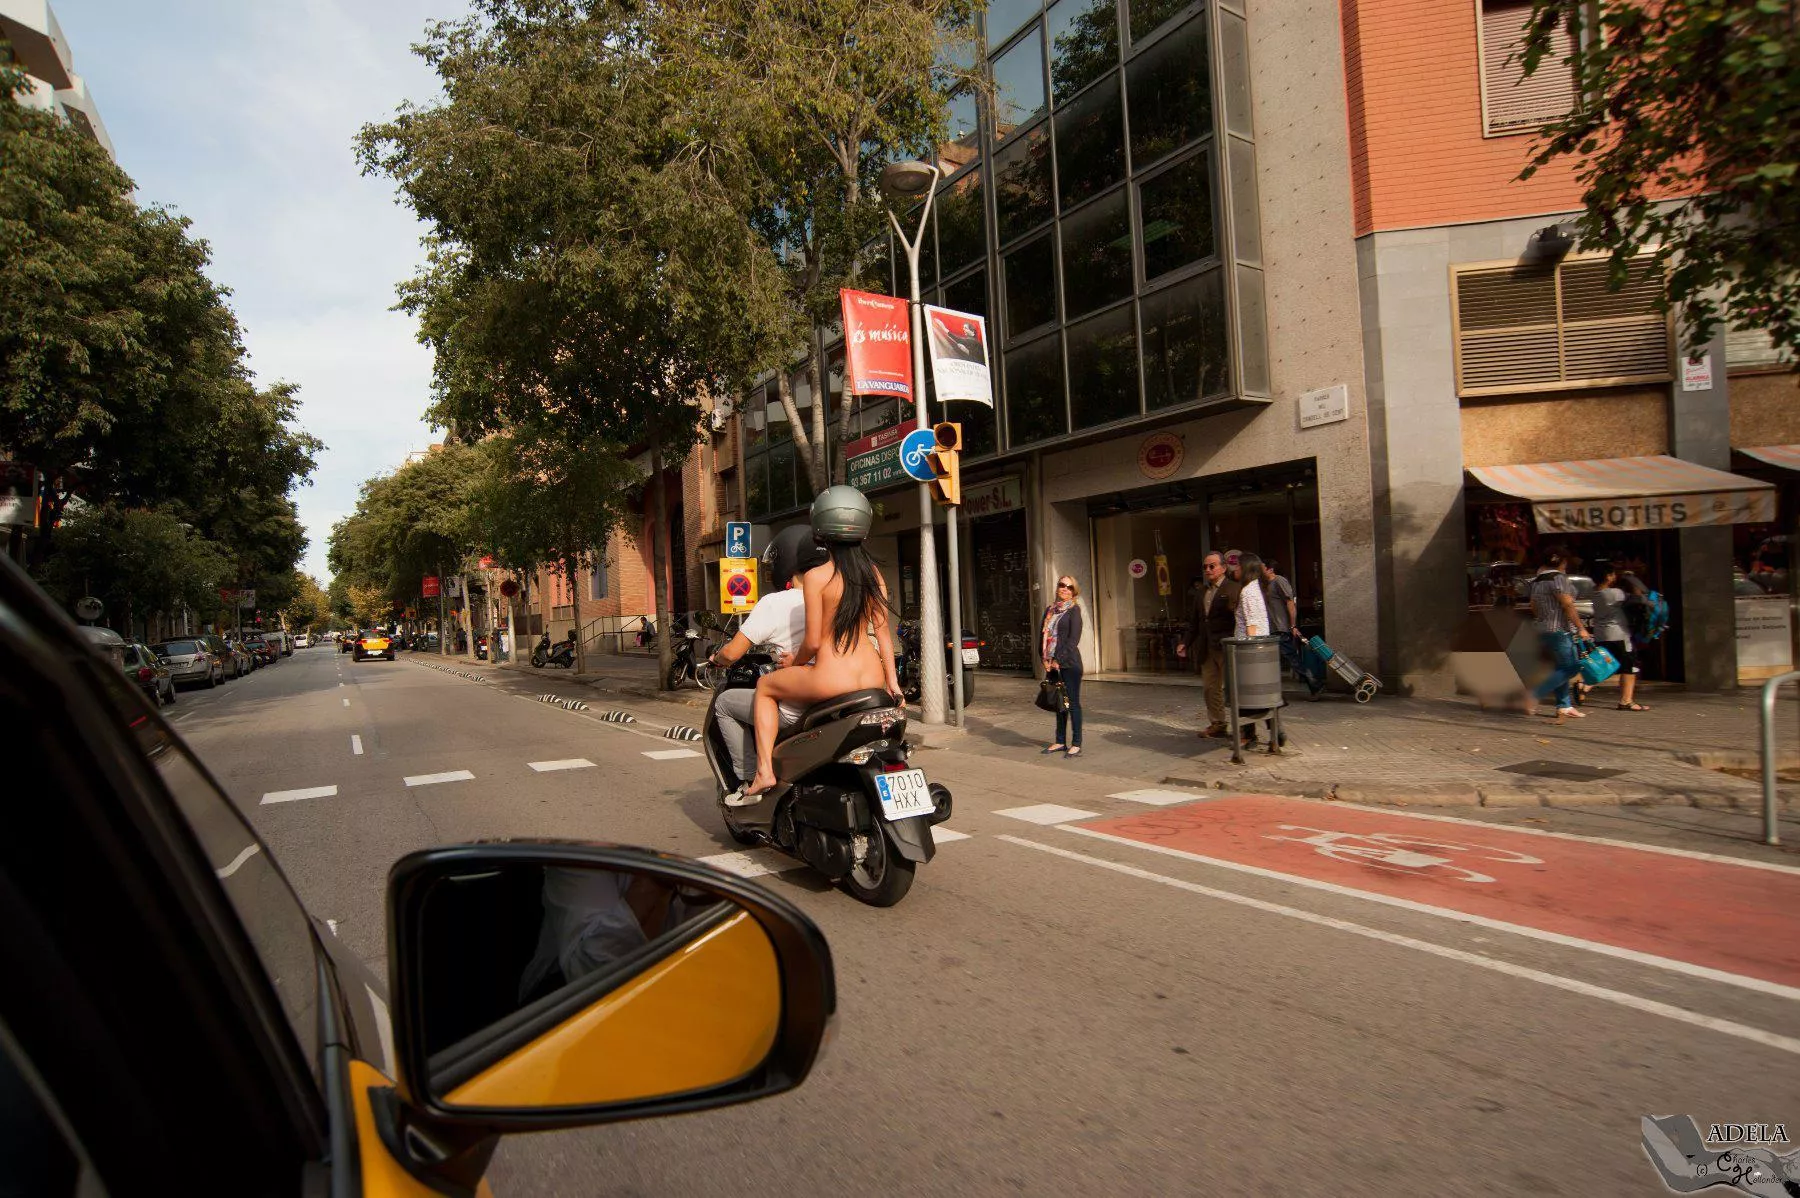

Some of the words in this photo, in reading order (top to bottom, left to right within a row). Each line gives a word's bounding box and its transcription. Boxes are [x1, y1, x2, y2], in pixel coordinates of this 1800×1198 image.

[869, 323, 909, 344] música
[850, 454, 880, 472] OFICINAS
[859, 472, 872, 486] 367
[873, 469, 881, 482] 11
[882, 466, 892, 479] 02
[1549, 502, 1688, 528] EMBOTITS
[733, 526, 745, 541] P
[887, 773, 924, 792] 7010
[893, 790, 921, 810] HXX
